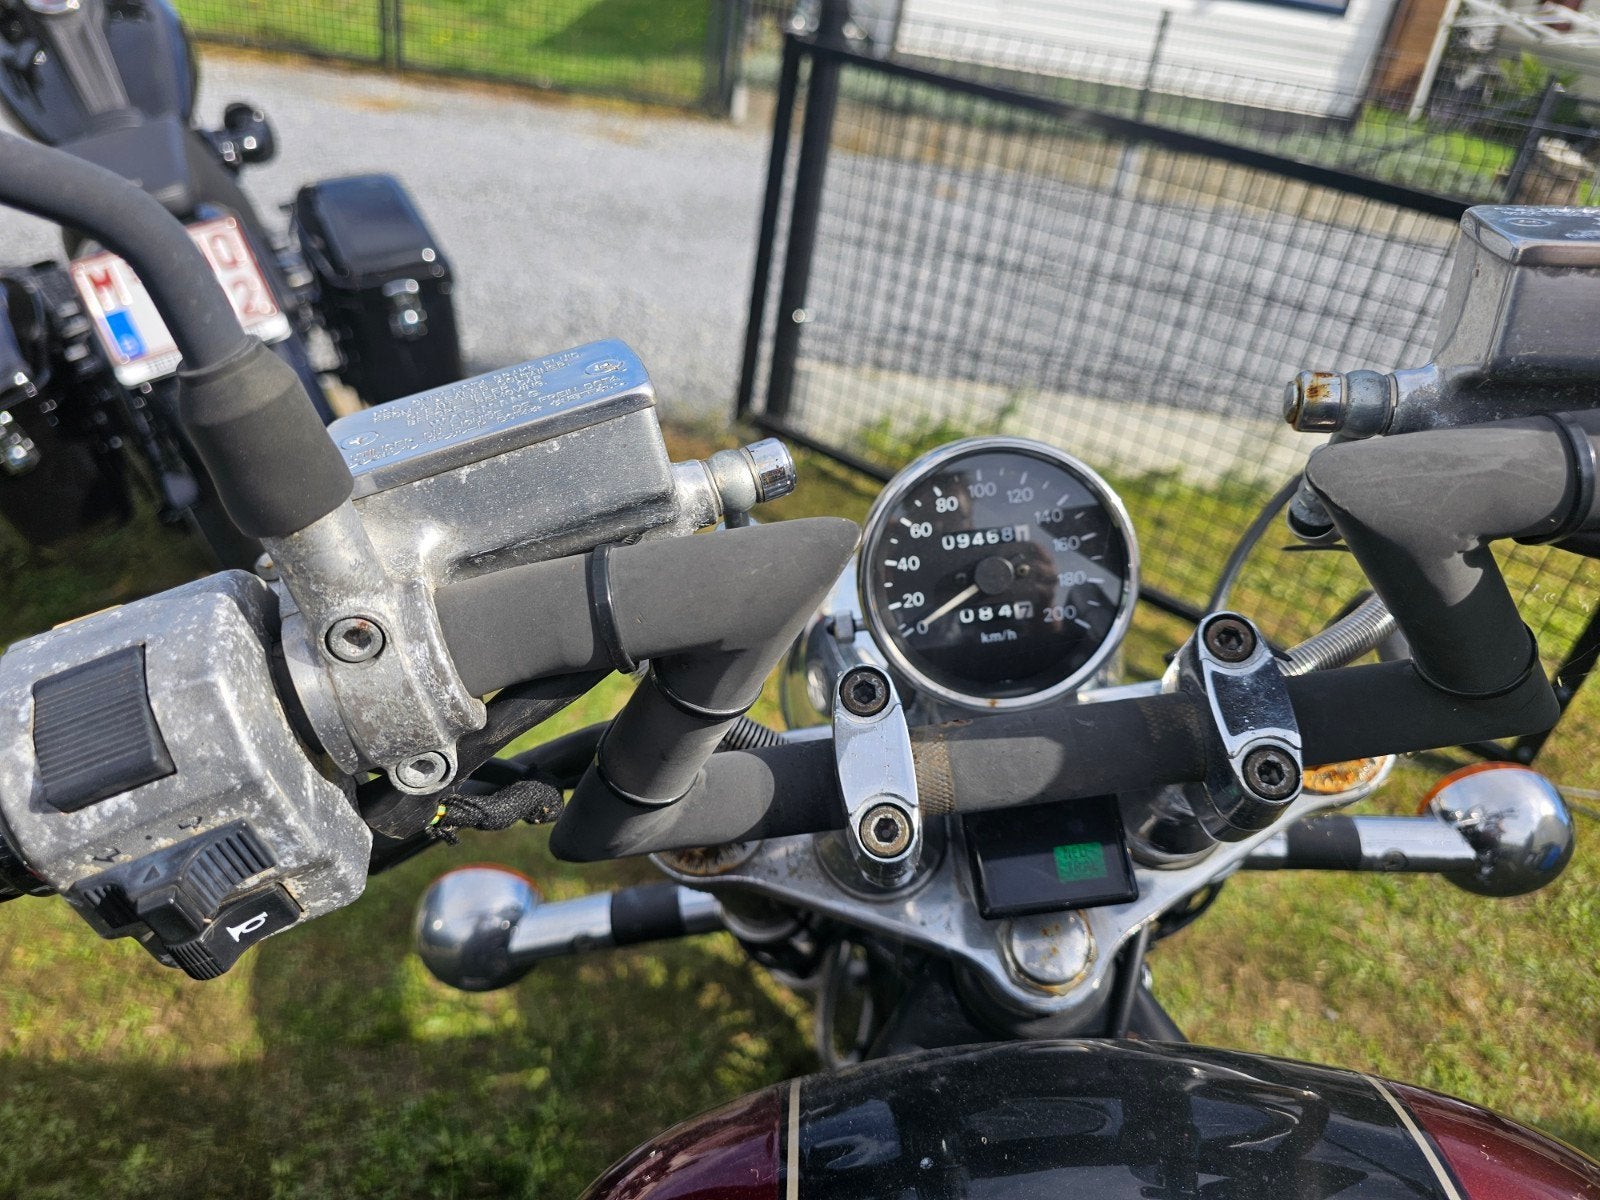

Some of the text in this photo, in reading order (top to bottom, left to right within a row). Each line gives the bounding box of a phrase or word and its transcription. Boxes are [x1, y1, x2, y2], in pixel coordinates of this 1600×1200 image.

[969, 483, 997, 497] 100
[1006, 487, 1034, 504] 120
[935, 495, 959, 513] 80
[1034, 508, 1064, 524] 140
[909, 521, 933, 539] 60
[1053, 535, 1081, 552] 160
[897, 555, 921, 571] 40
[1057, 569, 1087, 588] 180
[902, 591, 925, 608] 20
[1042, 605, 1077, 623] 200
[916, 620, 929, 634] 0
[980, 628, 1018, 644] km/h
